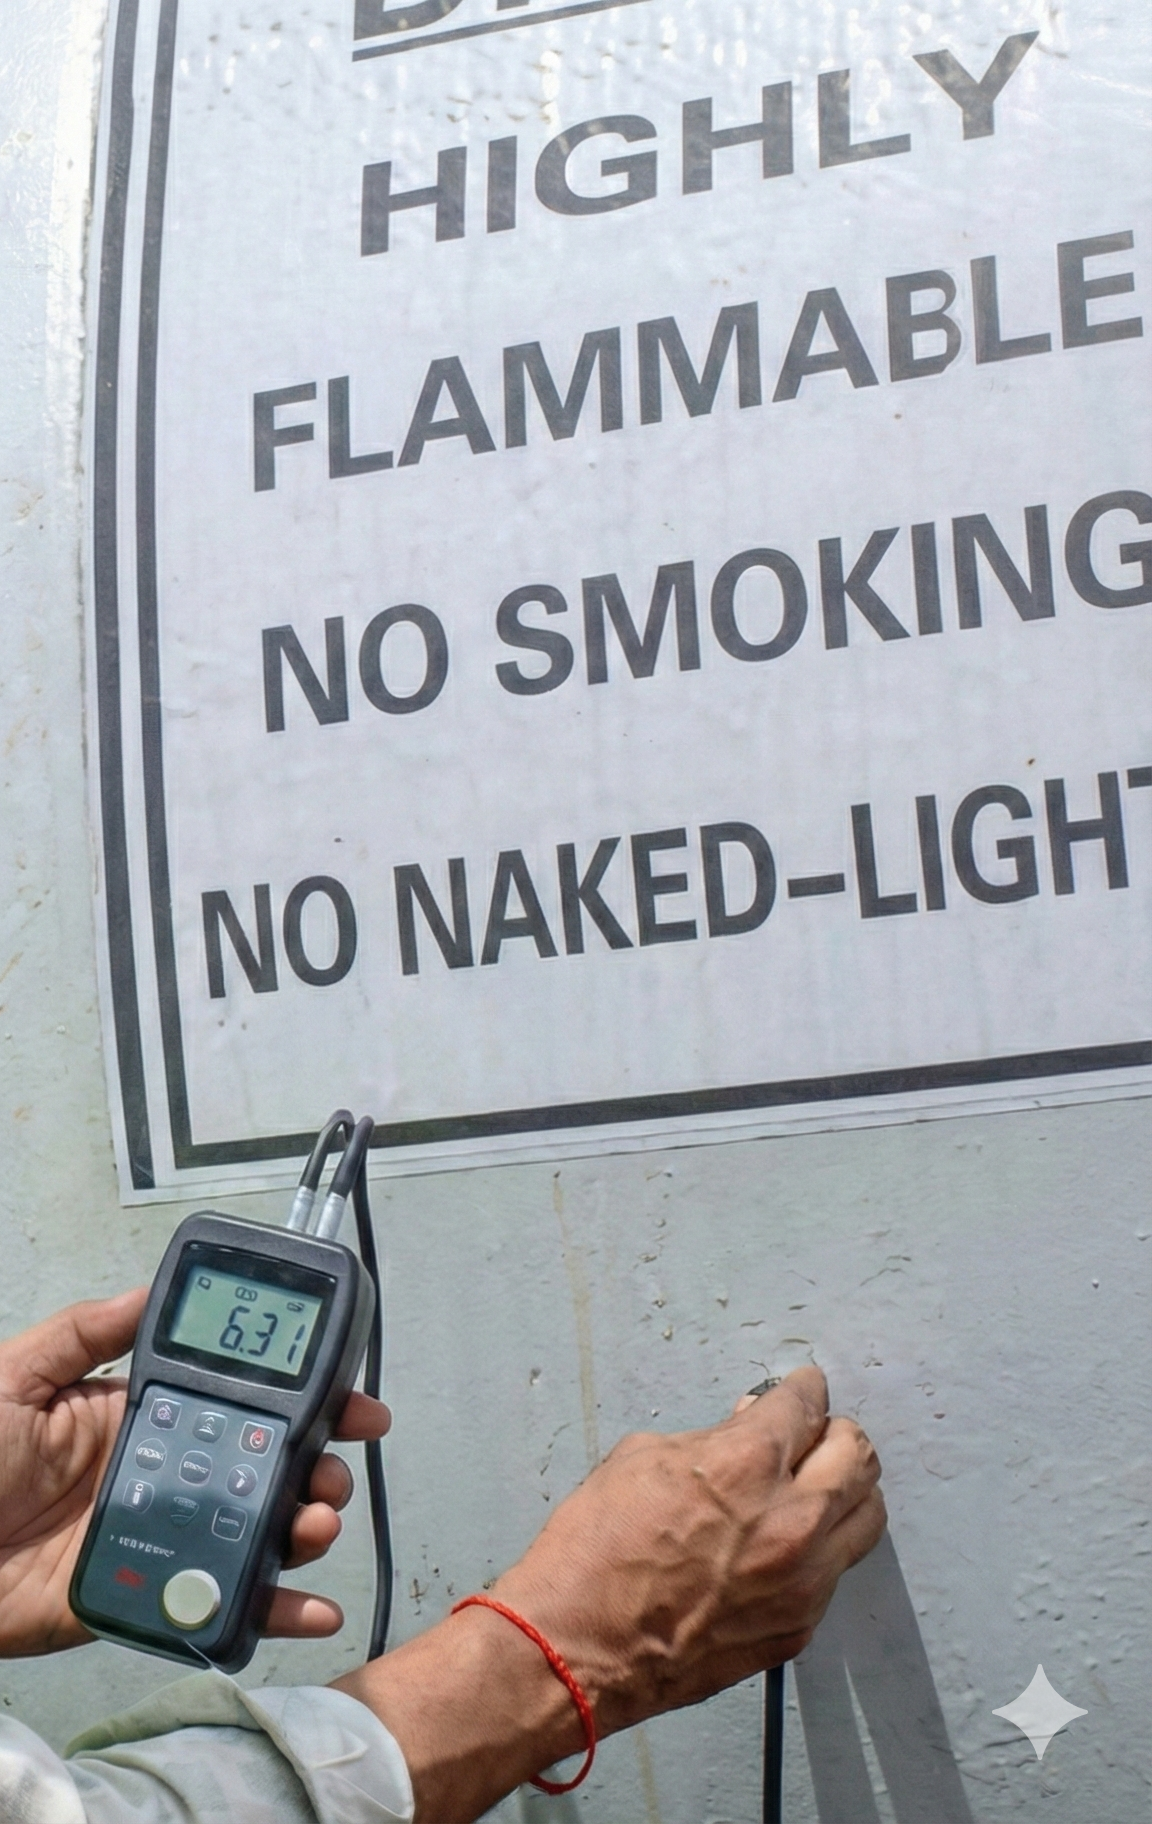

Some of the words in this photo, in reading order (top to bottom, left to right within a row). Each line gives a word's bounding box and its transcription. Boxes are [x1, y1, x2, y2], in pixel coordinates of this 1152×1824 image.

[360, 30, 1040, 258] HIGHLY
[252, 229, 1145, 494] FLAMMABLE
[261, 603, 450, 733] NO
[495, 489, 1152, 696] SMOKING
[201, 875, 357, 999] NO
[393, 766, 1152, 976] NAKED-LIGH
[219, 1305, 306, 1365] 6.31
